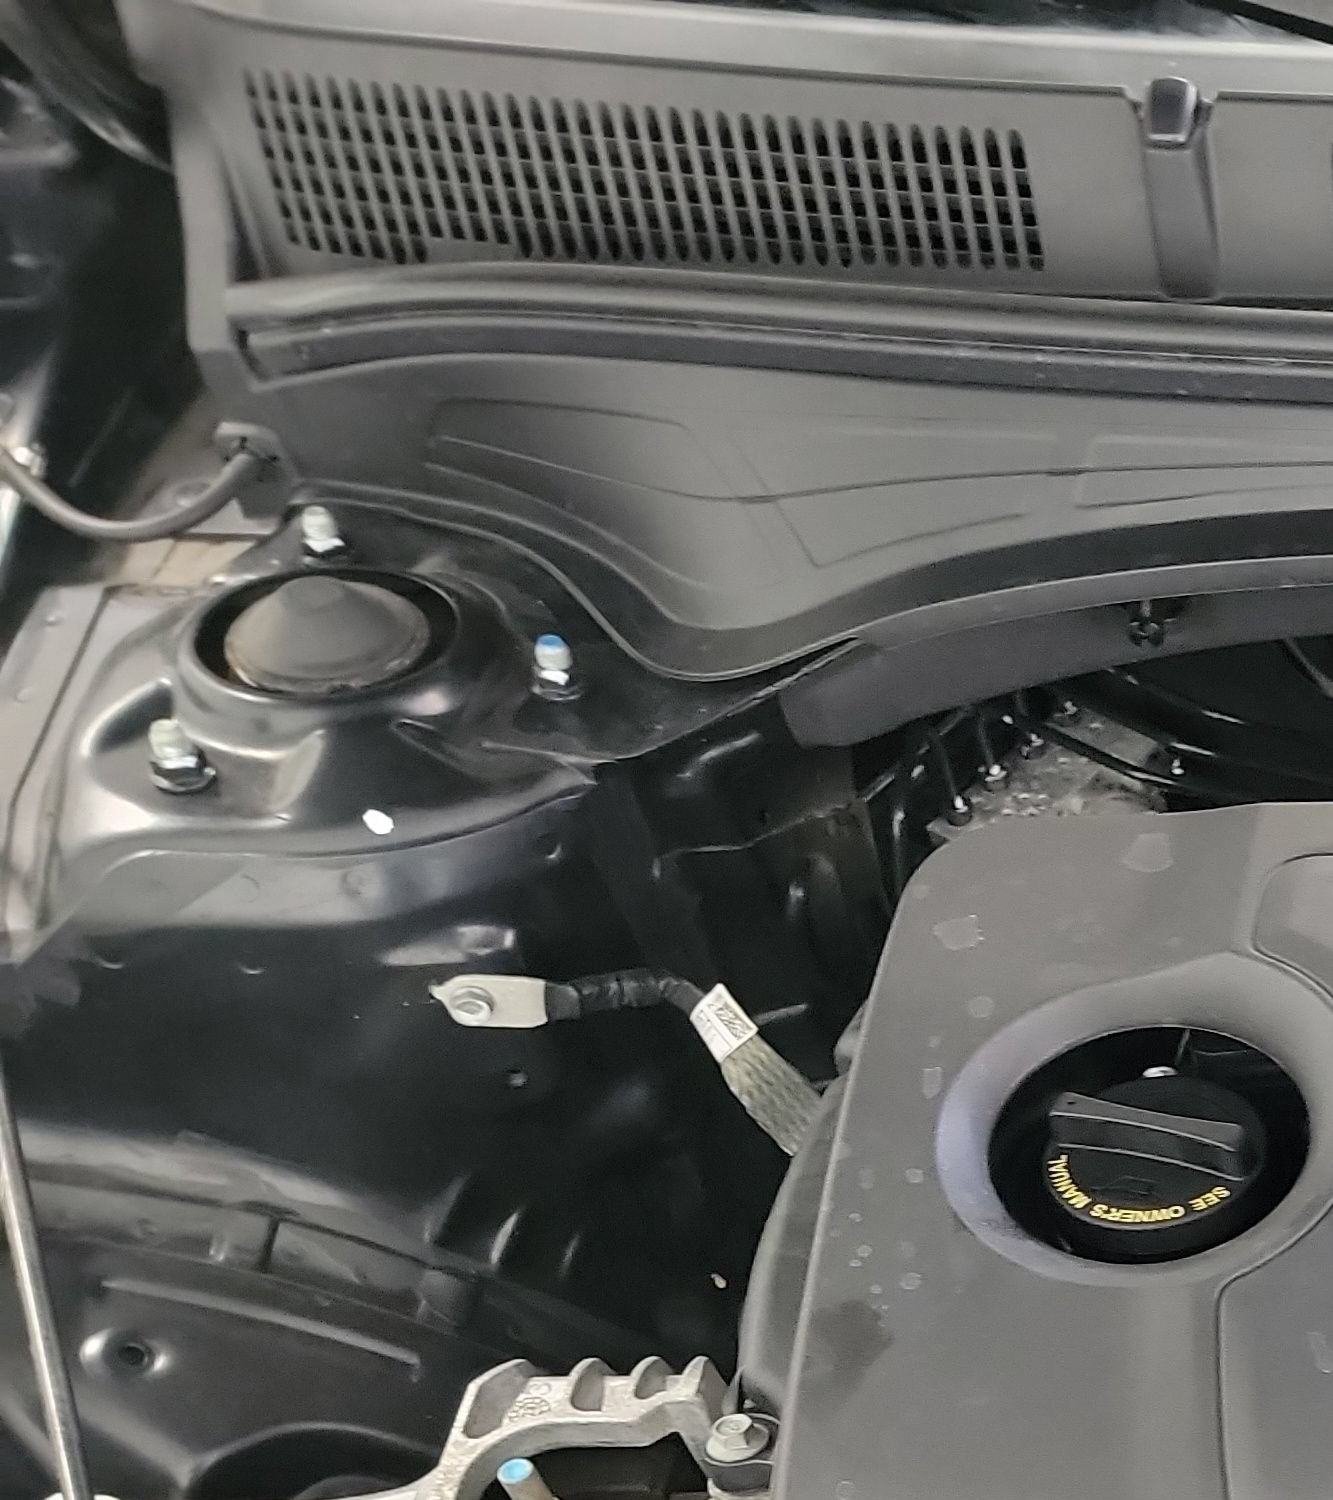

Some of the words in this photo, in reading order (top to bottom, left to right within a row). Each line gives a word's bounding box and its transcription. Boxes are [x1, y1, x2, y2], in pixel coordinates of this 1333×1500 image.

[1047, 1154, 1092, 1210] MANUAL
[1188, 1186, 1231, 1211] SEE
[1089, 1203, 1187, 1223] OWNER'S
